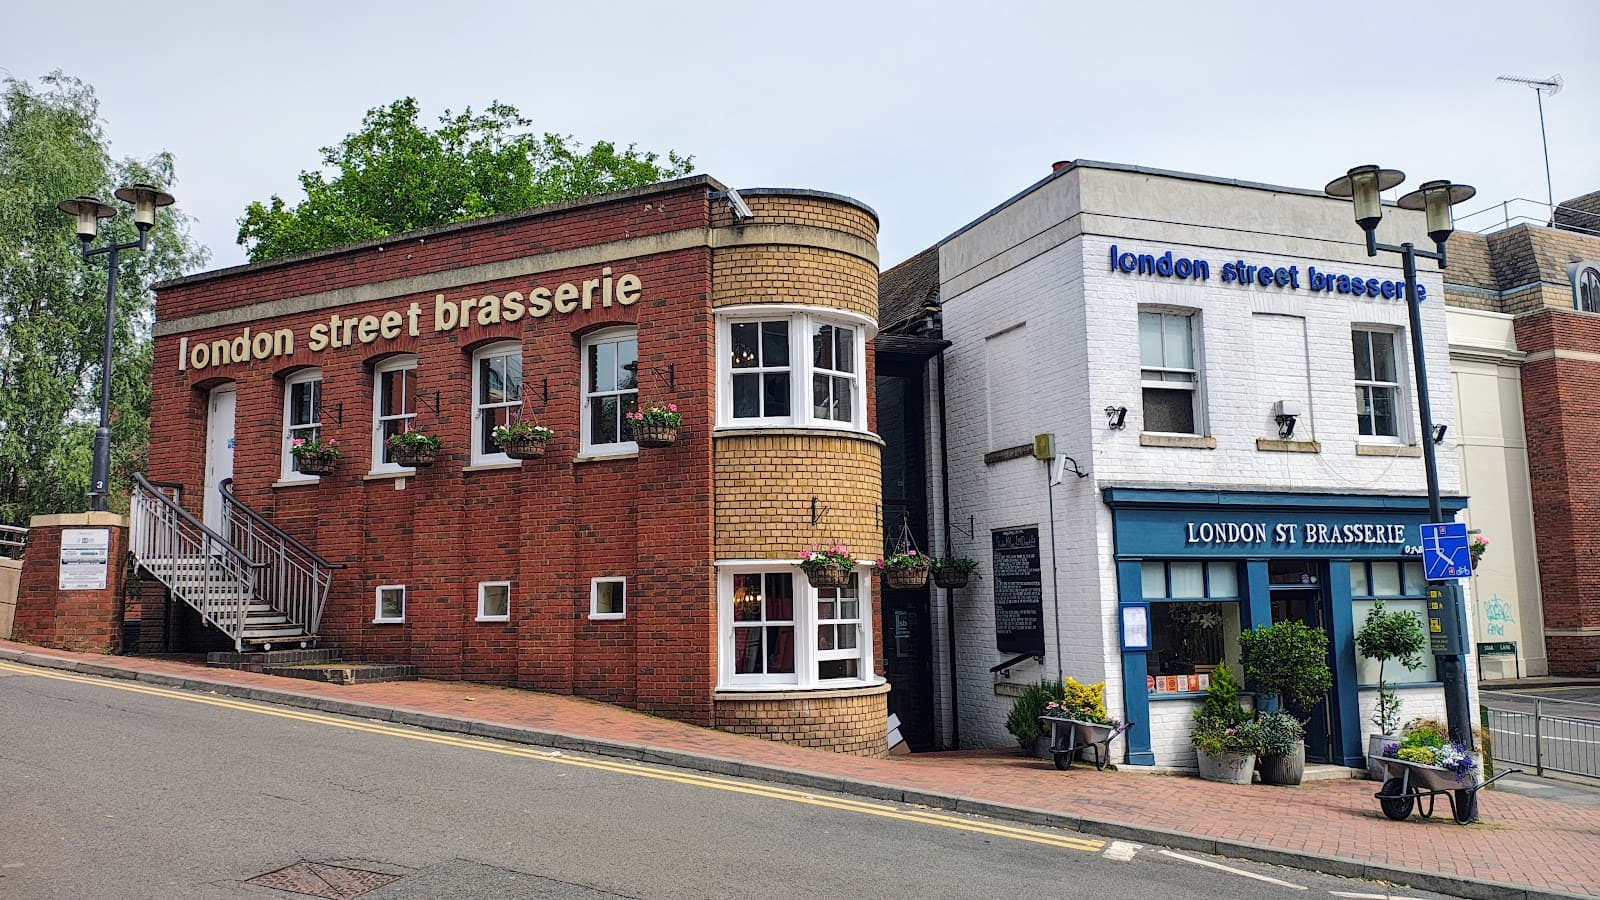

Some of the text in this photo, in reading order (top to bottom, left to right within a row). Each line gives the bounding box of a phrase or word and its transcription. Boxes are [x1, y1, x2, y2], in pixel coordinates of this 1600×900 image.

[1109, 244, 1427, 302] london street brassere
[178, 266, 642, 371] london street brasserie
[96, 480, 103, 488] 3
[1187, 522, 1406, 544] LONDON ST BRASSERIE
